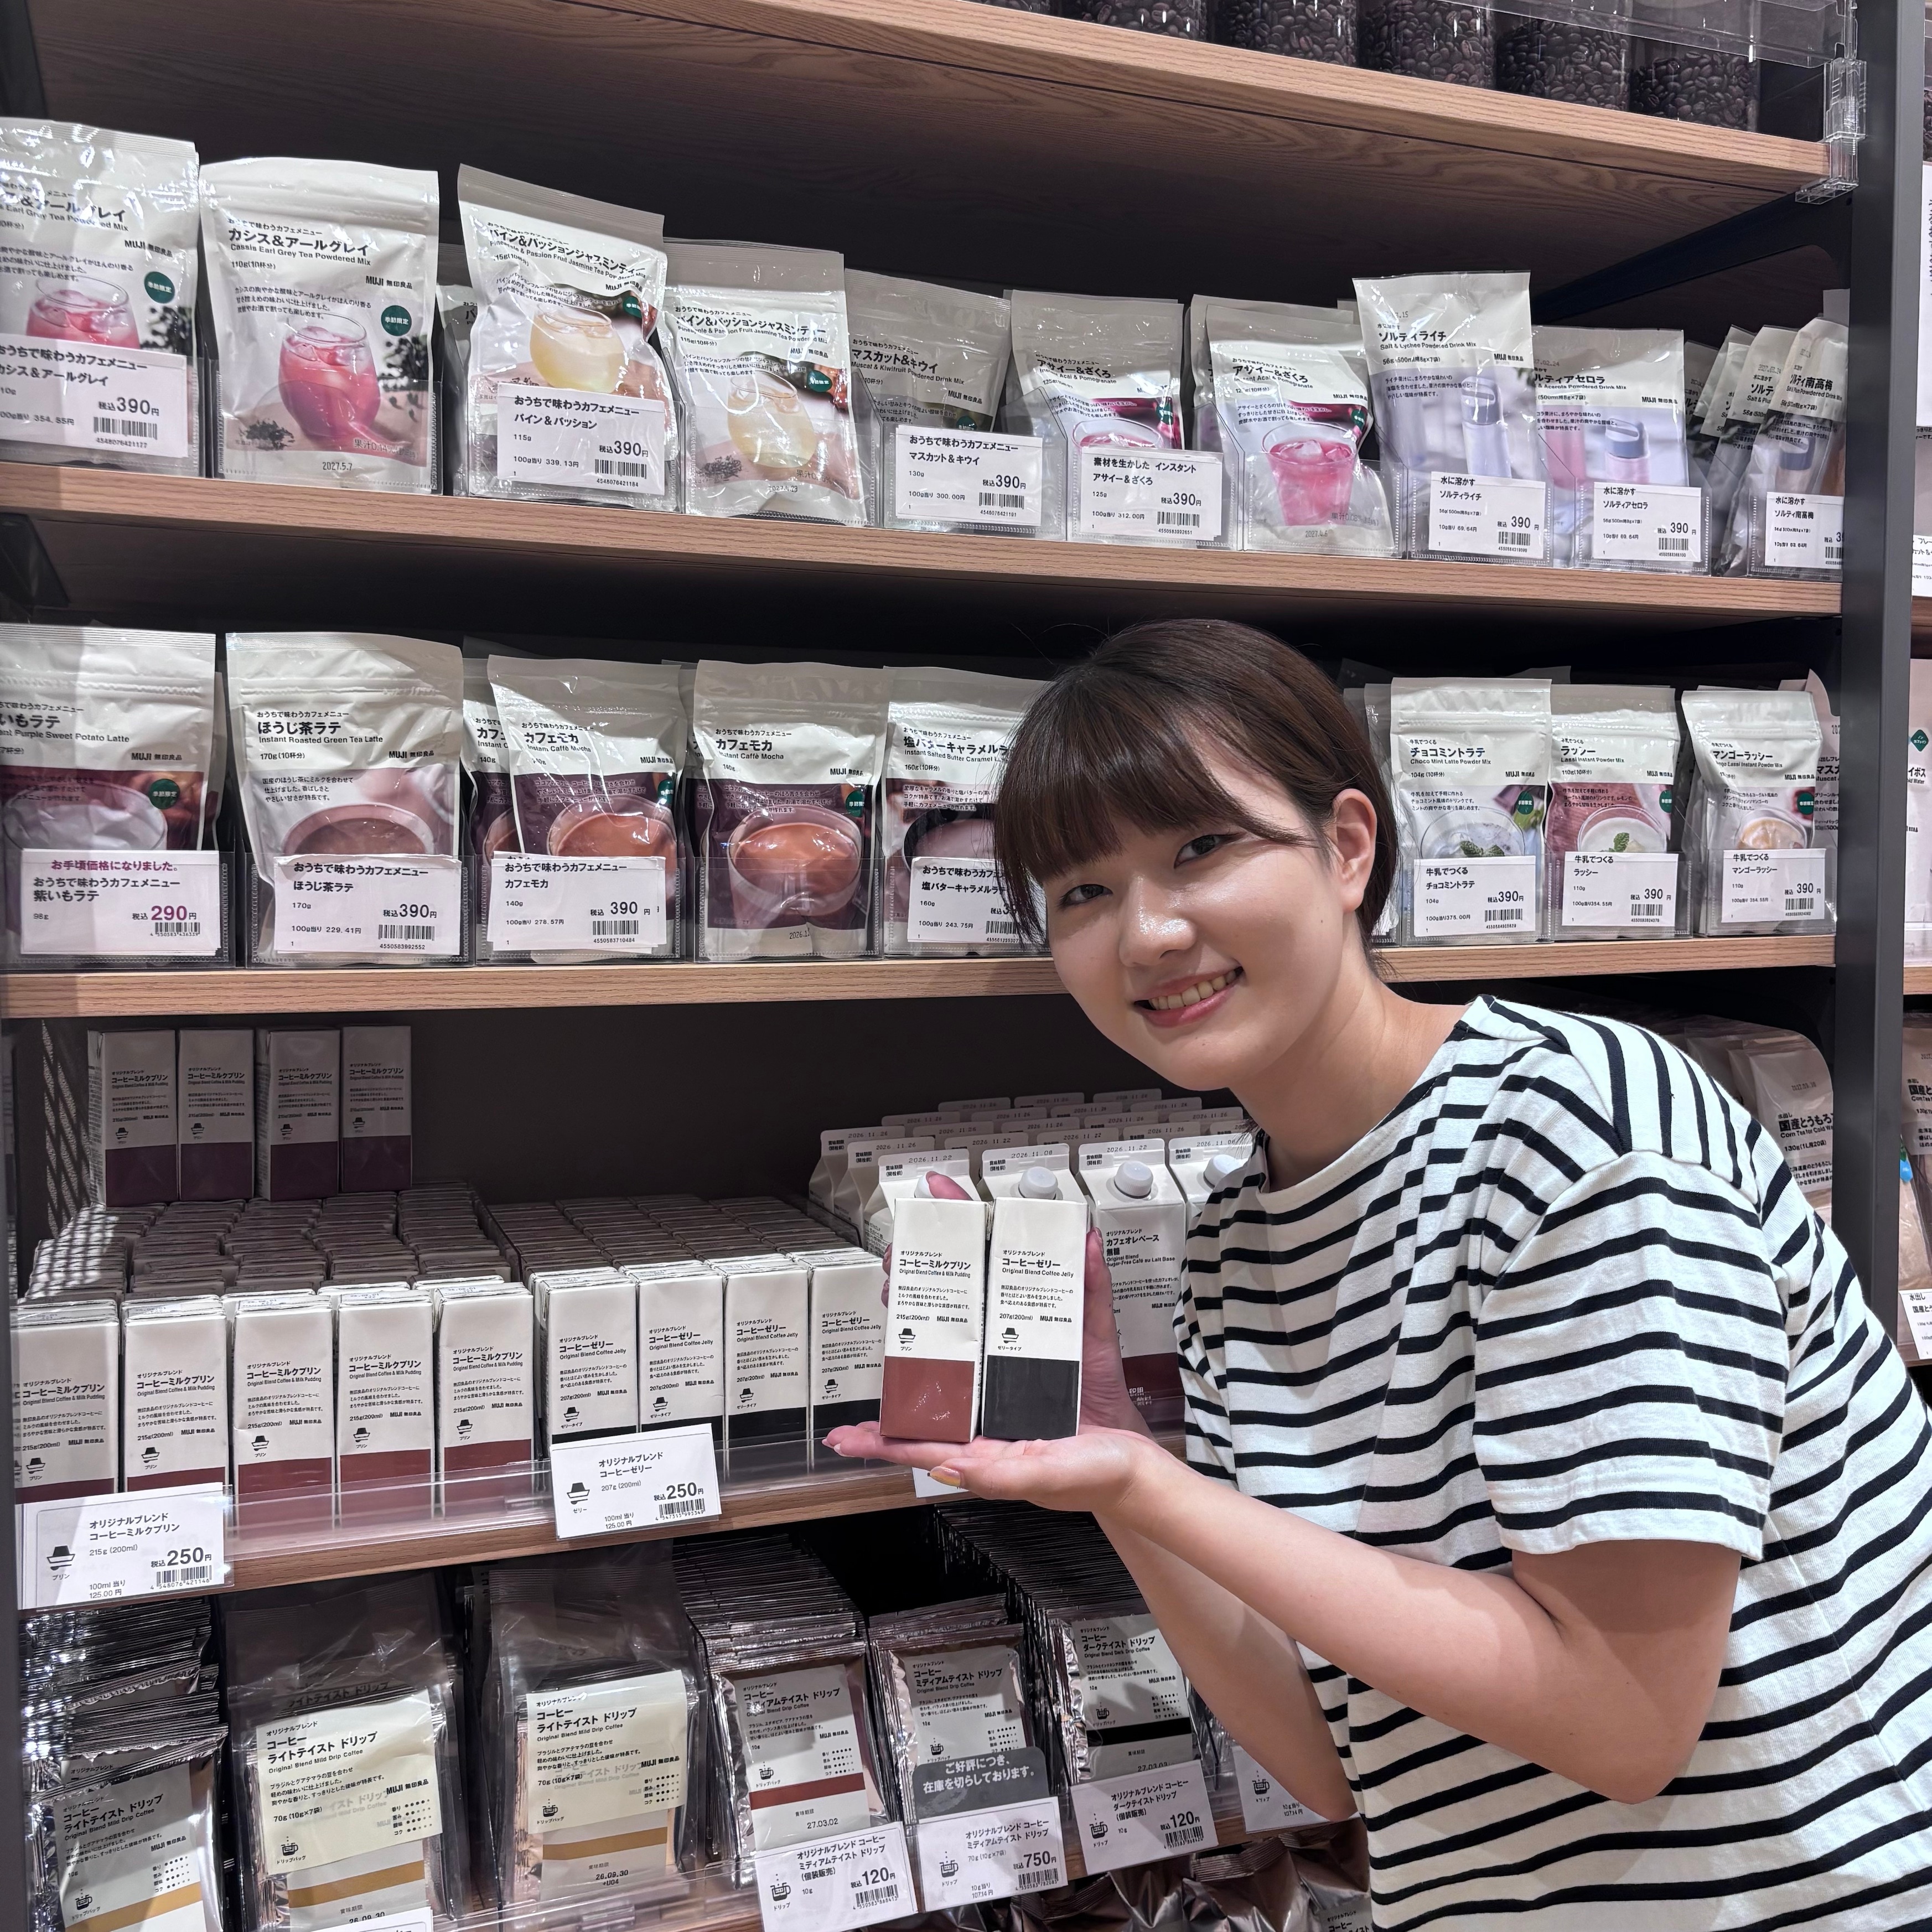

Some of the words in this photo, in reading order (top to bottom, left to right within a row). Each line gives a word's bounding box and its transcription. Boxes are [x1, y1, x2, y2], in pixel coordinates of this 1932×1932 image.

[229, 228, 370, 256] カシス&アールグレイ
[231, 244, 257, 252] Cassis
[278, 250, 296, 258] Grey
[315, 253, 355, 263] Powdered
[358, 257, 371, 266] Mix
[366, 276, 384, 286] MUJI
[386, 280, 412, 289] 無印良品
[1400, 343, 1421, 351] Lychee
[852, 349, 938, 374] マスカット&キウイ
[1232, 365, 1308, 382] アサイー&ざくろ
[948, 390, 961, 398] MUJI
[963, 394, 982, 404] 無印良品
[99, 397, 159, 416] 税込390円
[514, 396, 639, 416] おうちで味わうカフェメニュー
[599, 441, 648, 457] 税込390円
[910, 436, 1018, 452] おうちで味わうカフェメニュー
[910, 452, 979, 465] マスカット&キウイ
[322, 461, 353, 473] 2027.5.7
[1094, 458, 1149, 469] 素材を生かした
[1155, 463, 1196, 473] インスタント
[983, 475, 1025, 489] 税込390円
[1093, 473, 1153, 485] アサイー&ざくろ
[1441, 476, 1475, 486] 水に溶かす
[1161, 493, 1201, 506] 税込390円
[1440, 490, 1482, 500] ソルティライチ
[1775, 496, 1805, 505] 水に溶かす
[1604, 500, 1648, 509] ソルティアセロラ
[258, 721, 341, 735] ほうじ茶ラテ
[15, 730, 43, 739] Purple
[46, 732, 73, 740] Sweet
[75, 734, 105, 742] Potato
[716, 739, 773, 752] カフェモカ
[1411, 747, 1485, 758] チョコミントラテ
[1713, 750, 1773, 760] マンゴーラッシー
[52, 860, 178, 871] お手頃価格になりました。
[294, 862, 428, 877] おうちで味わうカフェメニュー
[505, 862, 626, 873] おうちで味わうカフェメニュー
[1426, 867, 1468, 876] 牛乳でつくる
[1574, 868, 1598, 877] ラッシー
[34, 878, 180, 888] おうちで味わうカフェメニュー
[293, 881, 353, 893] ほうじ茶ラテ
[505, 879, 548, 888] カフェモカ
[1426, 880, 1475, 890] チョコミントラテ
[34, 890, 99, 902] 紫いもラテ
[1488, 891, 1524, 903] 税込390円
[383, 904, 437, 919] 税込390円
[1106, 1234, 1159, 1247] カフェオレベース
[899, 1258, 971, 1270] コーヒーミルクプリン
[1002, 1258, 1060, 1268] コーヒーゼリー
[559, 1341, 613, 1354] コーヒーゼリー
[23, 1383, 105, 1397] コーヒーミルクプリン
[598, 1452, 663, 1468] オリジナルブレンド
[600, 1465, 652, 1478] コーヒーゼリー
[619, 1480, 641, 1489] (200ml)
[654, 1482, 704, 1501] 税込250円
[90, 1513, 168, 1530] オリジナルブレンド
[90, 1524, 180, 1541] コーヒーミルクプリン
[110, 1543, 138, 1554] (200ml)
[151, 1547, 211, 1568] 税込250円
[90, 1582, 111, 1591] 100ml
[90, 1590, 113, 1599] 125.00
[1083, 1640, 1126, 1651] ダークテイスト
[1130, 1636, 1156, 1648] ドリップ
[266, 1721, 318, 1737] オリジナルブレンド
[267, 1736, 307, 1750] コーヒー
[268, 1742, 335, 1764] ライトテイスト
[341, 1731, 377, 1748] ドリップ
[268, 1763, 292, 1774] Original
[295, 1759, 313, 1768] Blend
[314, 1755, 327, 1764] Mild
[329, 1753, 341, 1763] Drip
[344, 1749, 363, 1758] Coffee
[945, 1755, 1009, 1774] ご好評につき、
[271, 1767, 353, 1790] ブラジルとグアテマラの豆を合わせ
[923, 1765, 1034, 1794] 在庫を切らしております。
[271, 1778, 342, 1798] 軽めの味わいに仕上げました。
[386, 1783, 403, 1795] MUJI
[406, 1779, 429, 1790] 無印良品
[64, 1808, 125, 1833] ライトテイスト
[130, 1794, 164, 1812] ドリップ
[274, 1813, 287, 1822] 70g
[807, 1818, 838, 1829] 27.03.02
[965, 1822, 1021, 1839] オリジナルブレンド
[1024, 1819, 1049, 1829] コーヒー
[797, 1840, 856, 1860] オリジナルブレンド
[859, 1835, 885, 1847] コーヒー
[799, 1852, 857, 1870] ミディアムテイスト
[861, 1844, 885, 1857] ドリップ
